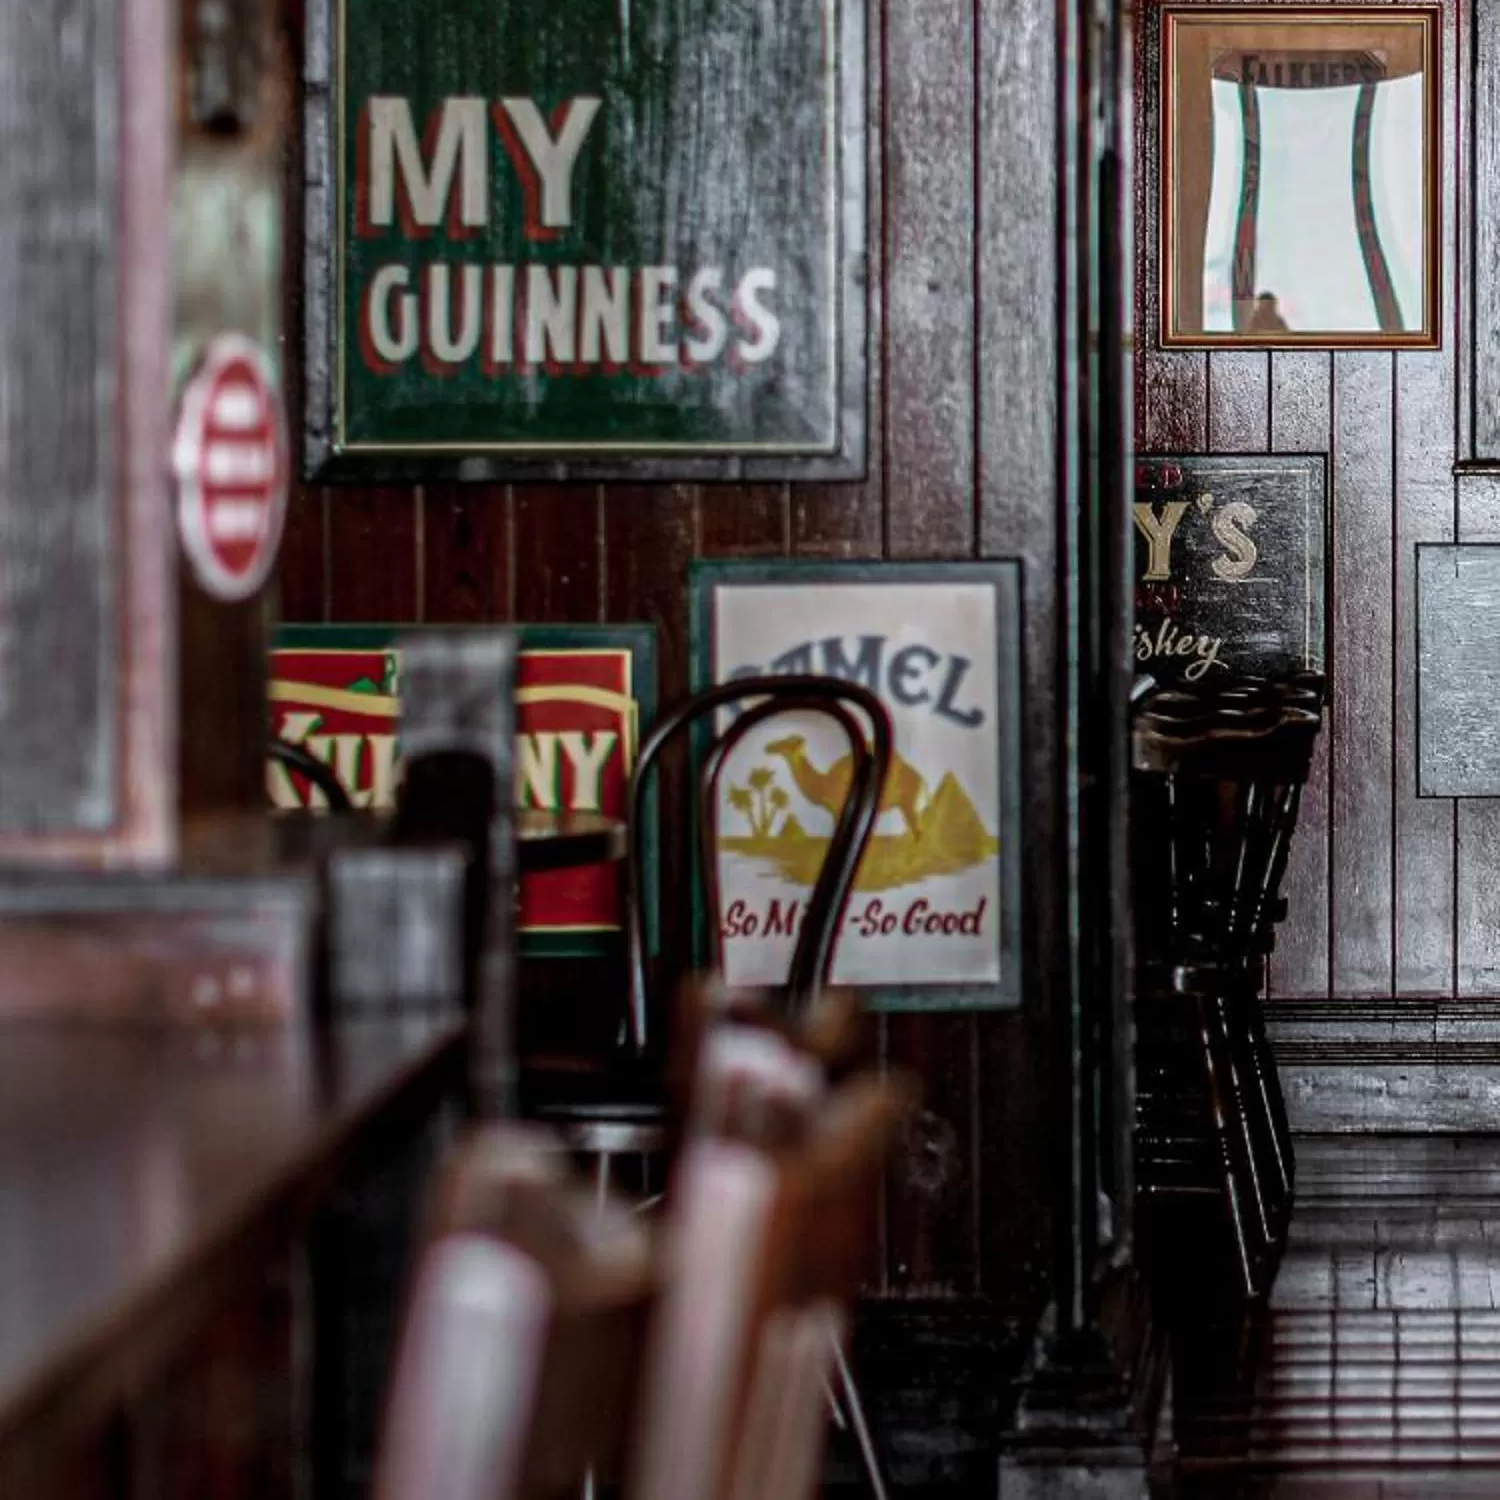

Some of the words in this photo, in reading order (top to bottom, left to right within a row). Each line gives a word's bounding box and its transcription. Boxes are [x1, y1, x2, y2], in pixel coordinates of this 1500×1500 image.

[355, 94, 604, 239] MY
[358, 261, 782, 377] GUINNESS
[1132, 492, 1258, 583] Y'S
[1131, 617, 1229, 681] iskey
[722, 898, 756, 939] So
[902, 895, 987, 937] Good
